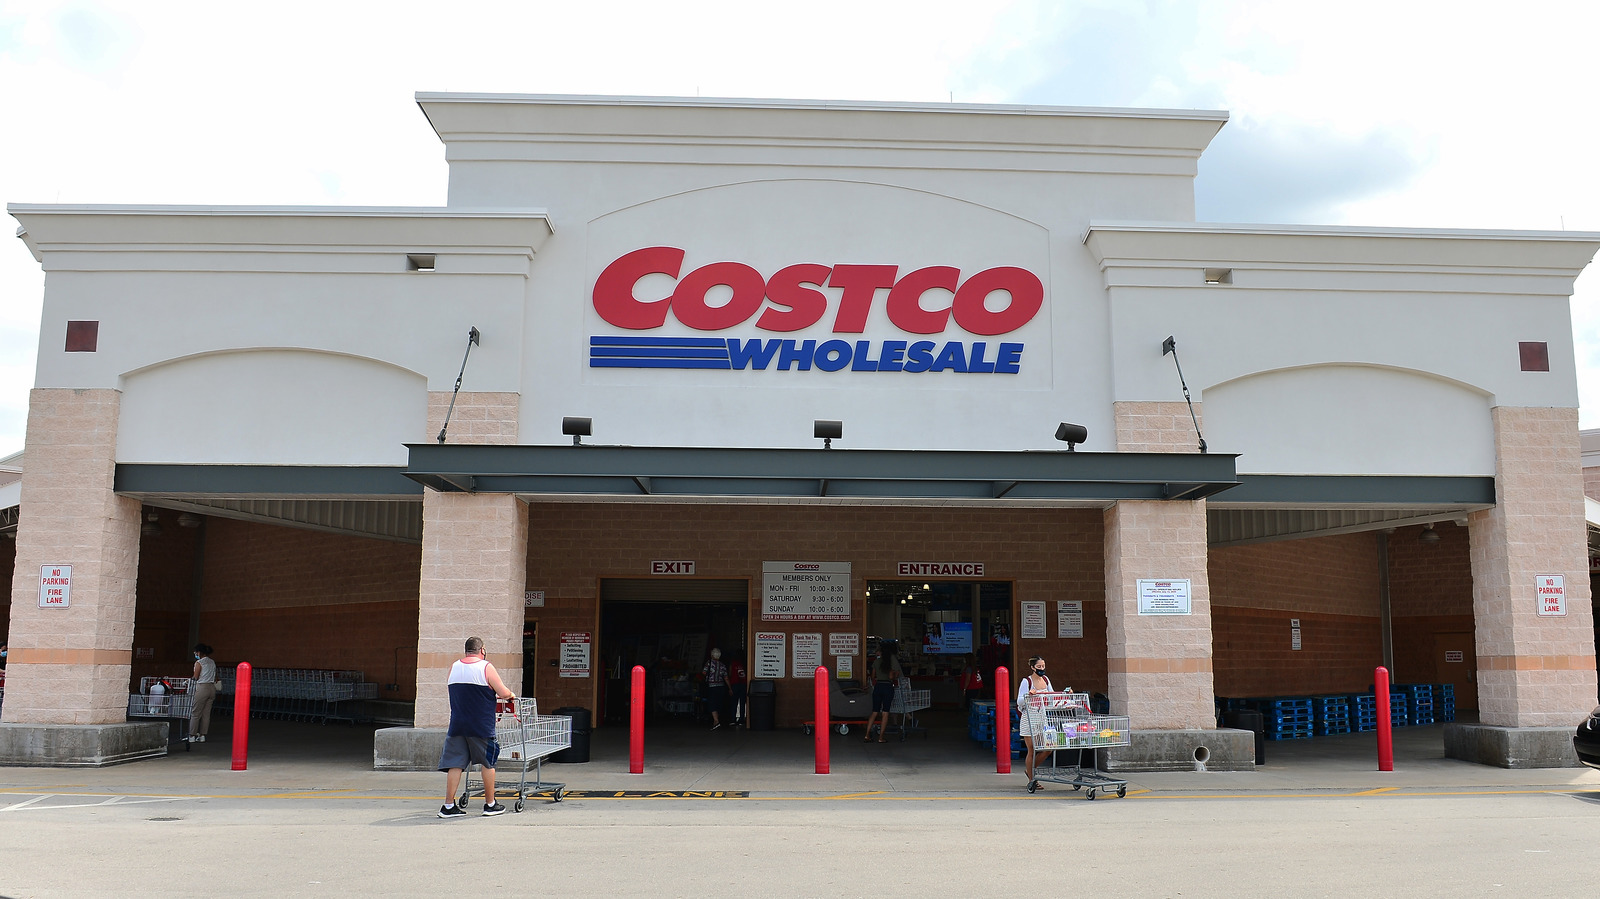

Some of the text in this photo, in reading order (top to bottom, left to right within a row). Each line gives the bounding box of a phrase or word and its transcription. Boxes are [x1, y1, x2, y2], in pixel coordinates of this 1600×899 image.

[592, 246, 1044, 336] COSTCO
[726, 338, 1024, 375] WHOLESALE
[52, 569, 62, 577] NO
[653, 562, 693, 573] EXIT
[899, 563, 983, 575] ENTRANCE
[42, 577, 69, 585] PARKING
[1546, 578, 1554, 586] NO
